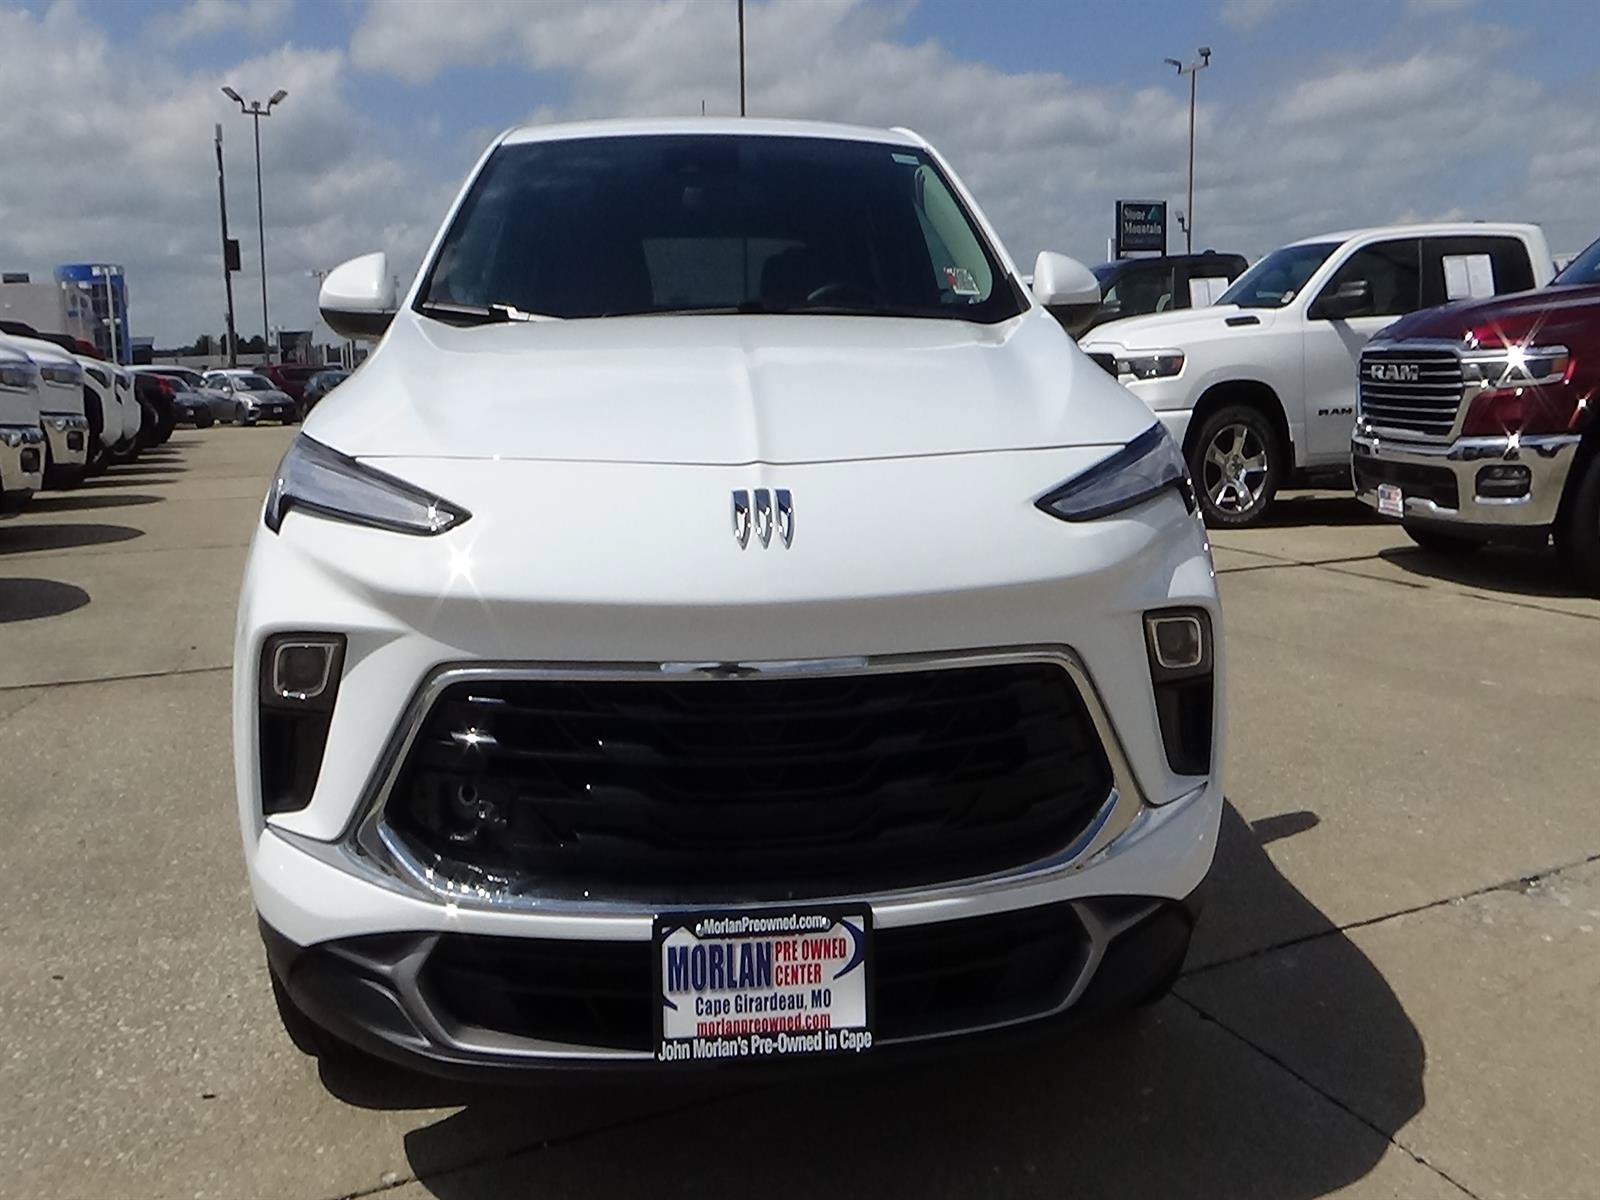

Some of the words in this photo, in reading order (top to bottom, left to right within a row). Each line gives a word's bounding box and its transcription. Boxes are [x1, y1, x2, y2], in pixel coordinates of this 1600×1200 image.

[1371, 364, 1419, 380] RAM
[1318, 407, 1353, 417] RAM
[703, 914, 825, 935] MorlanPreowned.com
[775, 940, 799, 962] PRE
[801, 937, 847, 959] OWNED
[667, 941, 773, 993] MORLAN
[775, 963, 822, 987] CENTER
[695, 997, 731, 1017] Cape
[734, 991, 808, 1015] Girardeau,
[811, 988, 832, 1008] MO
[658, 1040, 691, 1062] John
[693, 1035, 749, 1057] Morlan's
[751, 1030, 822, 1052] Pre-Owned
[824, 1029, 837, 1048] in
[839, 1028, 873, 1052] Cape
